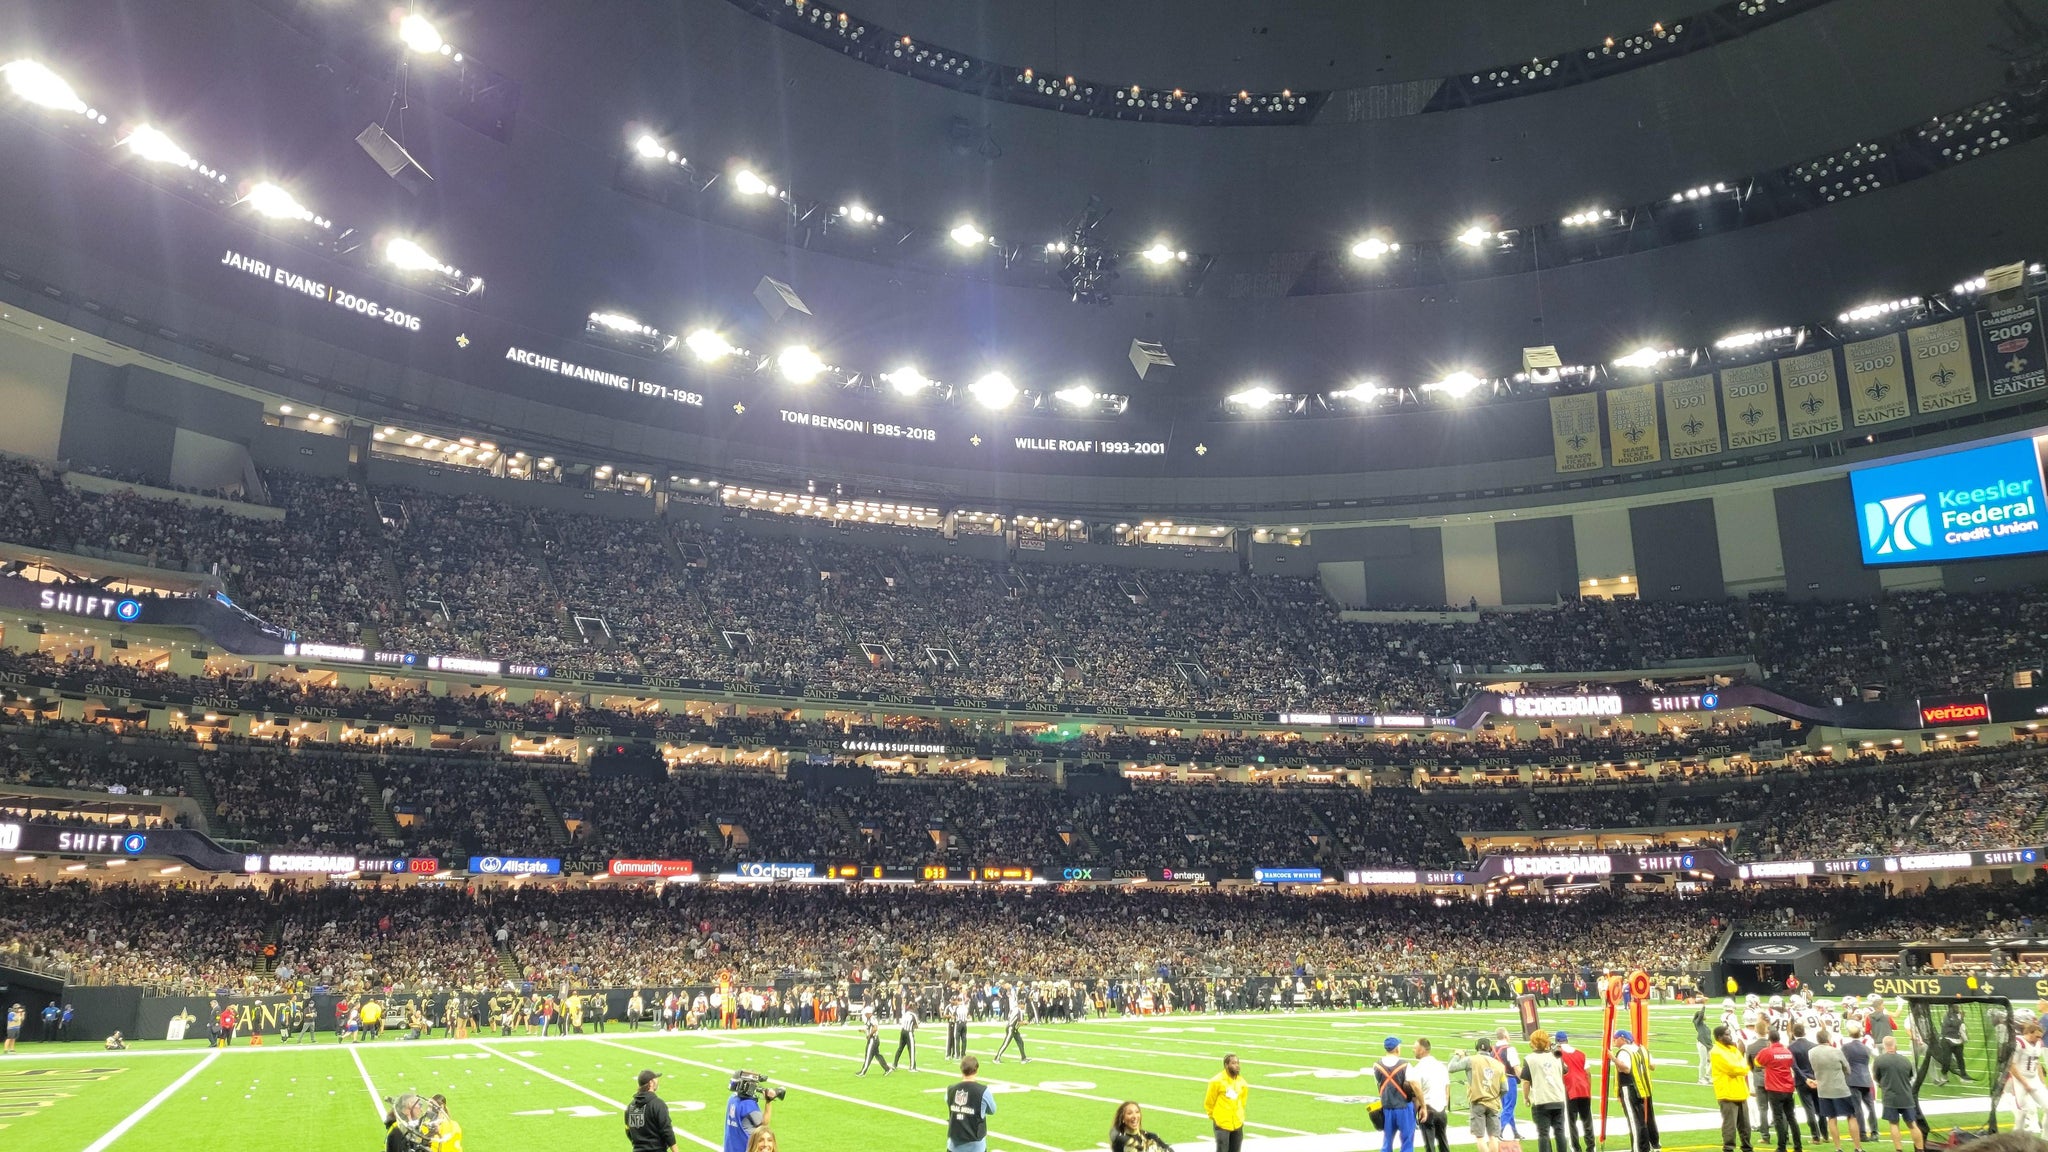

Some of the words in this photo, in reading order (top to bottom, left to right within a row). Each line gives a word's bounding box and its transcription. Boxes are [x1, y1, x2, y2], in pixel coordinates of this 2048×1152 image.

[221, 250, 271, 279] JAHRI
[274, 268, 325, 299] EVANS
[335, 290, 421, 331] 2006-2016
[1991, 304, 2024, 317] WORLD
[1982, 308, 2035, 327] CHAMPIONS
[1989, 322, 2033, 342] 2009
[1918, 340, 1960, 359] 2009
[1854, 355, 1895, 373] 2009
[506, 347, 558, 372] ARCHIE
[561, 362, 629, 390] MANNING
[637, 379, 704, 407] 1971-1982
[1789, 370, 1829, 388] 2006
[1729, 382, 1768, 398] 2000
[1993, 375, 2046, 396] SAINTS
[1674, 394, 1705, 409] 1991
[1922, 392, 1972, 411] SAINTS
[1857, 406, 1906, 424] SAINTS
[780, 409, 809, 426] TOM
[811, 413, 863, 433] BENSON
[872, 422, 936, 442] 1985-2018
[1792, 420, 1839, 437] SAINTS
[1732, 432, 1776, 447] SAINTS
[1015, 437, 1056, 451] WILLIE
[1058, 439, 1092, 453] ROAF
[1100, 441, 1165, 454] 1993-2001
[1674, 443, 1718, 458] SAINTS
[1618, 455, 1654, 464] HOLDERS
[1622, 450, 1649, 458] TICKET
[1562, 462, 1597, 471] HOLDERS
[1939, 478, 2033, 509] Keesler
[1942, 496, 2035, 529] Federal
[1945, 525, 1990, 544] Credit
[1992, 519, 2039, 535] Union
[1020, 540, 1044, 548] WWL
[41, 590, 115, 617] SHIFT
[375, 652, 405, 664] SHIFT
[509, 664, 538, 676] SHIFT
[554, 669, 595, 682] SAINTS
[641, 677, 680, 688] SAINTS
[85, 683, 131, 698] SAINTS
[723, 683, 760, 694] SAINTS
[803, 688, 839, 699] SAINTS
[192, 696, 239, 709] SAINTS
[878, 693, 914, 704] SAINTS
[953, 699, 987, 708] SAINTS
[1025, 702, 1058, 712] SAINTS
[1096, 706, 1128, 715] SAINTS
[1515, 696, 1621, 716] SCOREBOARD
[1652, 696, 1700, 711] SHIFT
[294, 706, 338, 718] SAINTS
[1164, 709, 1197, 719] SAINTS
[1232, 712, 1264, 721] SAINTS
[1923, 705, 1986, 722] verizon
[394, 713, 435, 725] SAINTS
[1338, 716, 1358, 724] SHIFT
[485, 719, 524, 731] SAINTS
[574, 725, 612, 736] SAINTS
[655, 730, 691, 741] SAINTS
[731, 735, 766, 745] SAINTS
[806, 739, 840, 749] SAINTS
[842, 740, 891, 751] CAESARS
[891, 744, 945, 753] SUPERDOME
[945, 746, 975, 755] SAINTS
[1013, 749, 1043, 758] SAINTS
[1081, 751, 1111, 760] SAINTS
[1623, 750, 1656, 760] SAINTS
[1697, 745, 1731, 755] SAINTS
[1146, 753, 1176, 762] SAINTS
[1214, 755, 1244, 764] SAINTS
[1278, 756, 1308, 765] SAINTS
[1345, 757, 1374, 765] SAINTS
[1409, 758, 1439, 766] SAINTS
[1479, 757, 1511, 766] SAINTS
[1549, 755, 1581, 764] SAINTS
[59, 833, 123, 851] SHIFT
[1985, 852, 2021, 863] SHIFT
[359, 860, 392, 871] SHIFT
[411, 860, 435, 872] 0:03
[564, 861, 603, 872] SAINTS
[613, 860, 662, 874] Community
[750, 863, 811, 878] Ochsner
[1514, 857, 1611, 874] SCOREBOARD
[1638, 857, 1682, 870] SHIFT
[1825, 861, 1858, 871] SHIFT
[1063, 868, 1092, 879] COX
[1114, 869, 1146, 878] SAINTS
[1173, 871, 1205, 881] entergy
[1427, 873, 1455, 883] SHIFT
[1873, 978, 1941, 995] SAINTS
